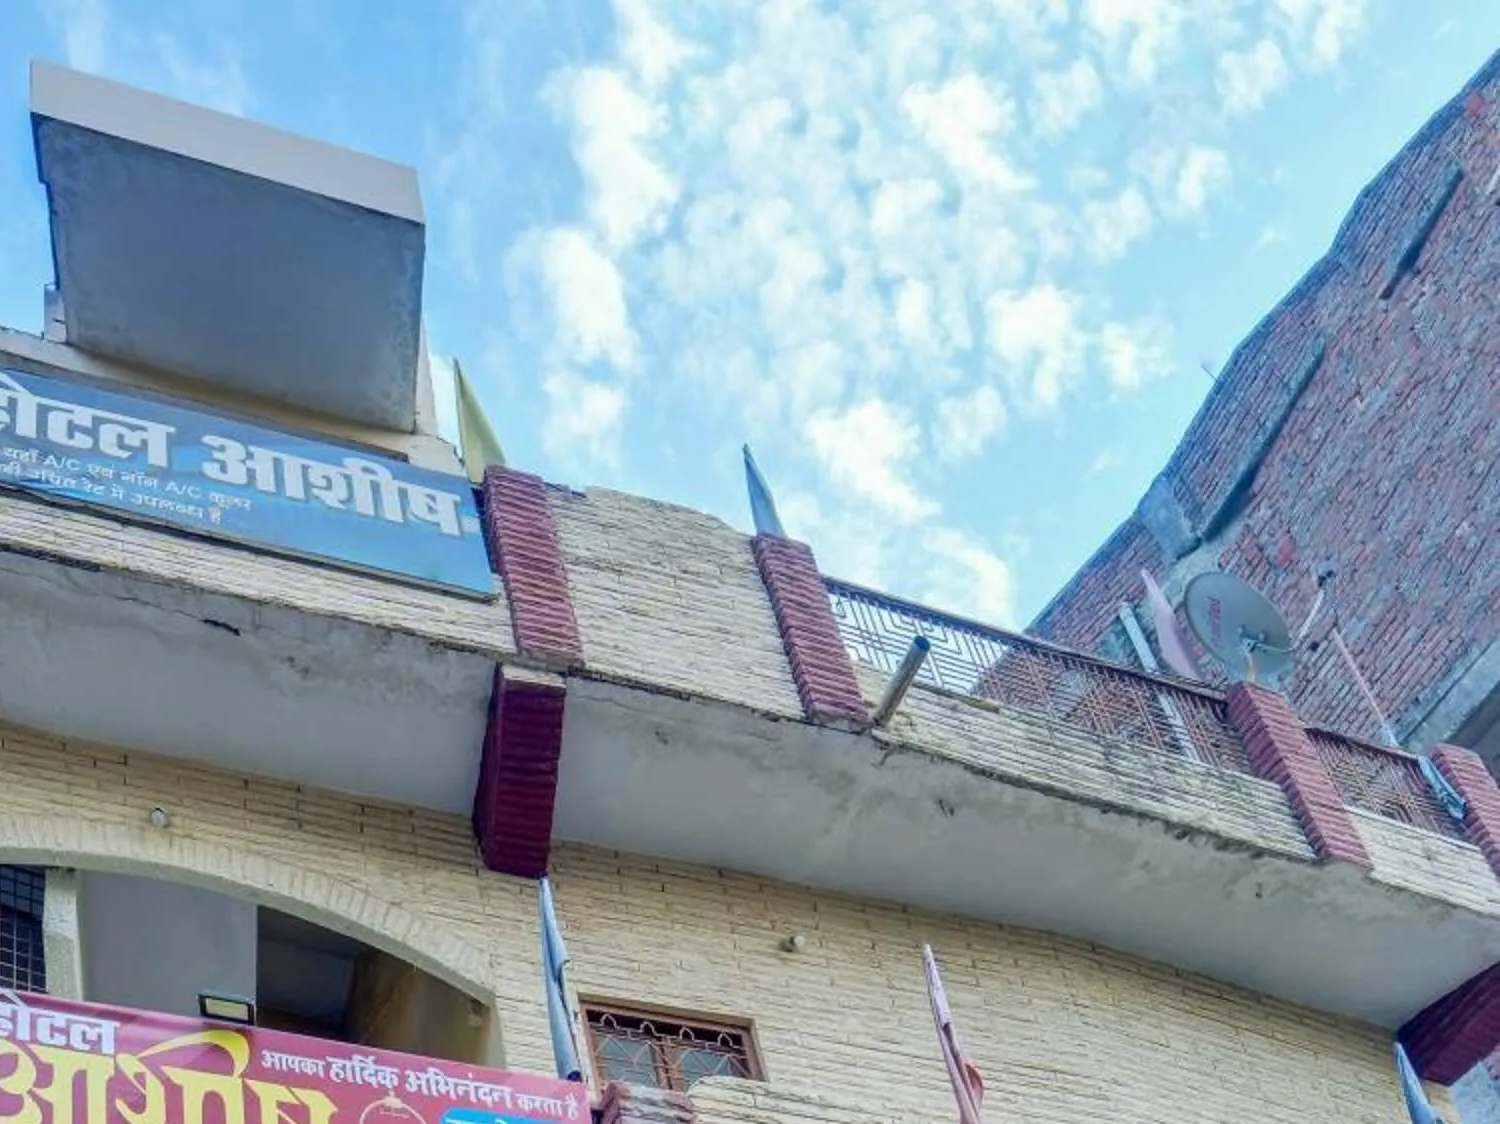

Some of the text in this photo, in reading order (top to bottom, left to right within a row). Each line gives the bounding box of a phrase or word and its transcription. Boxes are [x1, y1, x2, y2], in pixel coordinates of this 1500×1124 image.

[43, 455, 81, 471] A/C
[165, 480, 200, 499] A/C
[201, 434, 464, 536] आशीष
[261, 1051, 580, 1121] आपका हार्दिक अभिनंदन करता है
